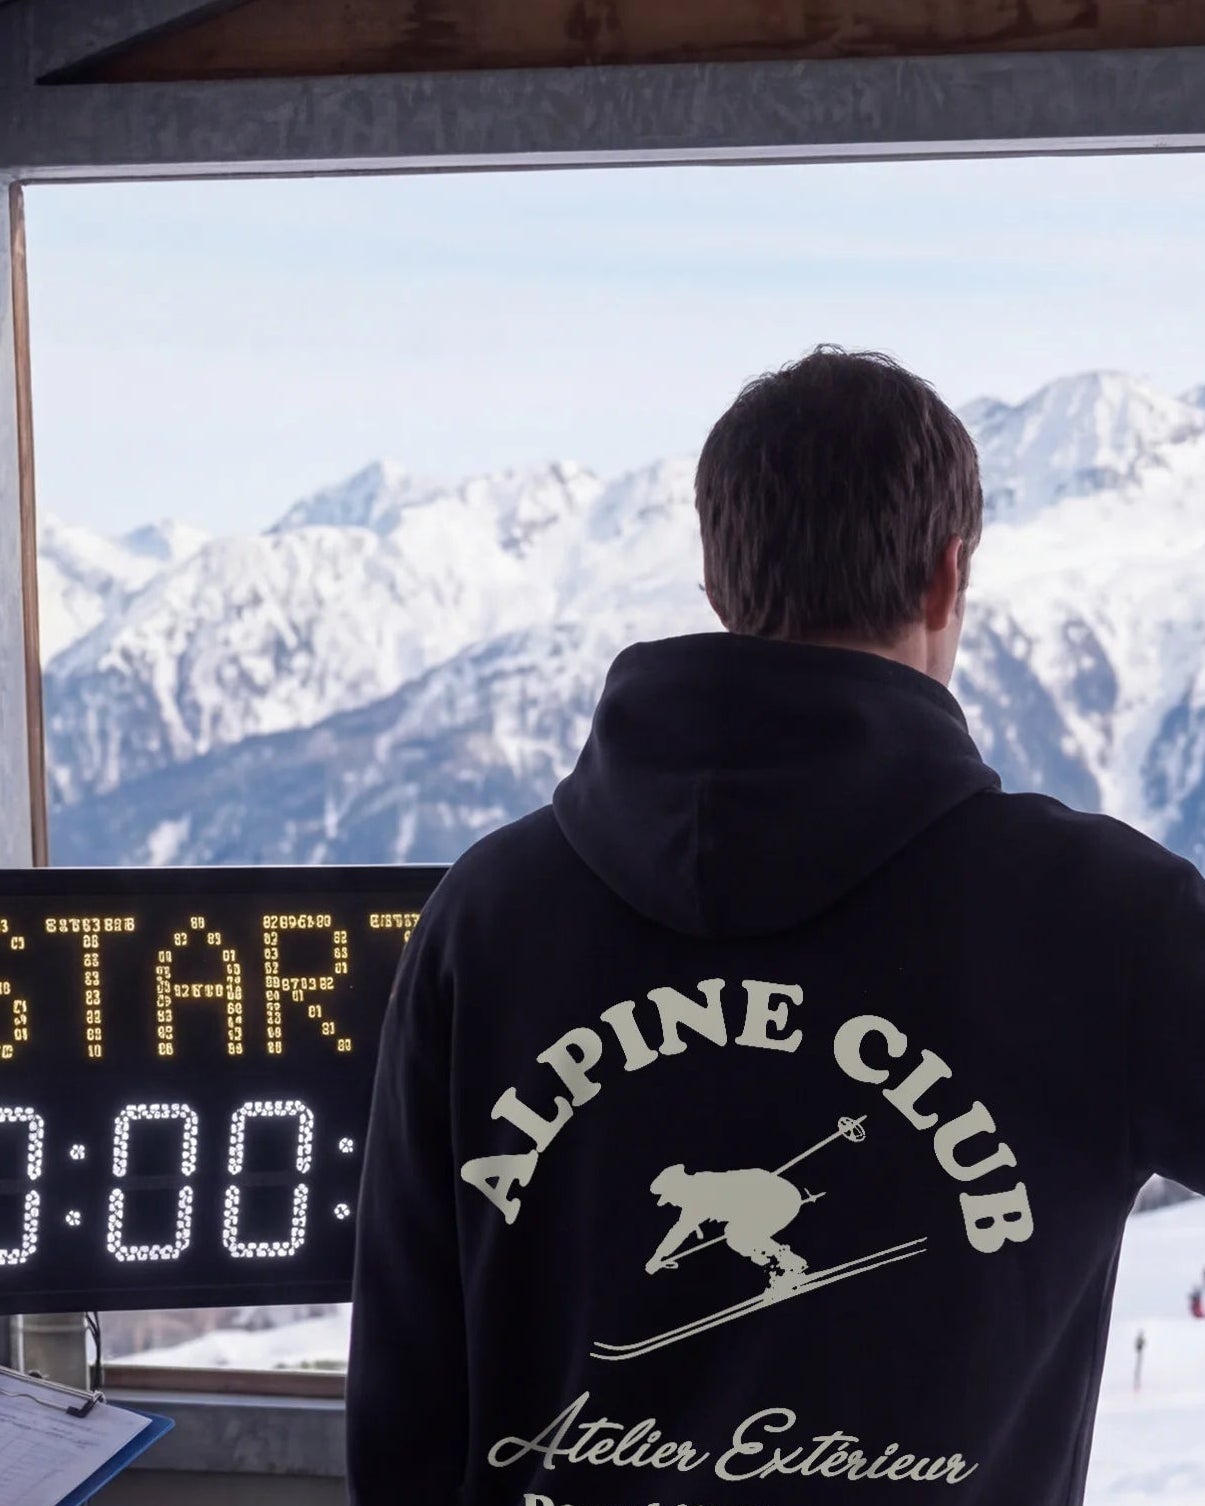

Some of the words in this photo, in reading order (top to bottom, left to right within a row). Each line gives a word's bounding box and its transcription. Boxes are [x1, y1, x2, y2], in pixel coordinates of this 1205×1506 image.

[460, 978, 804, 1224] ALPINE
[833, 1014, 1034, 1254] CLUB
[487, 1390, 711, 1472] Atelier
[714, 1407, 979, 1485] Extérieur
